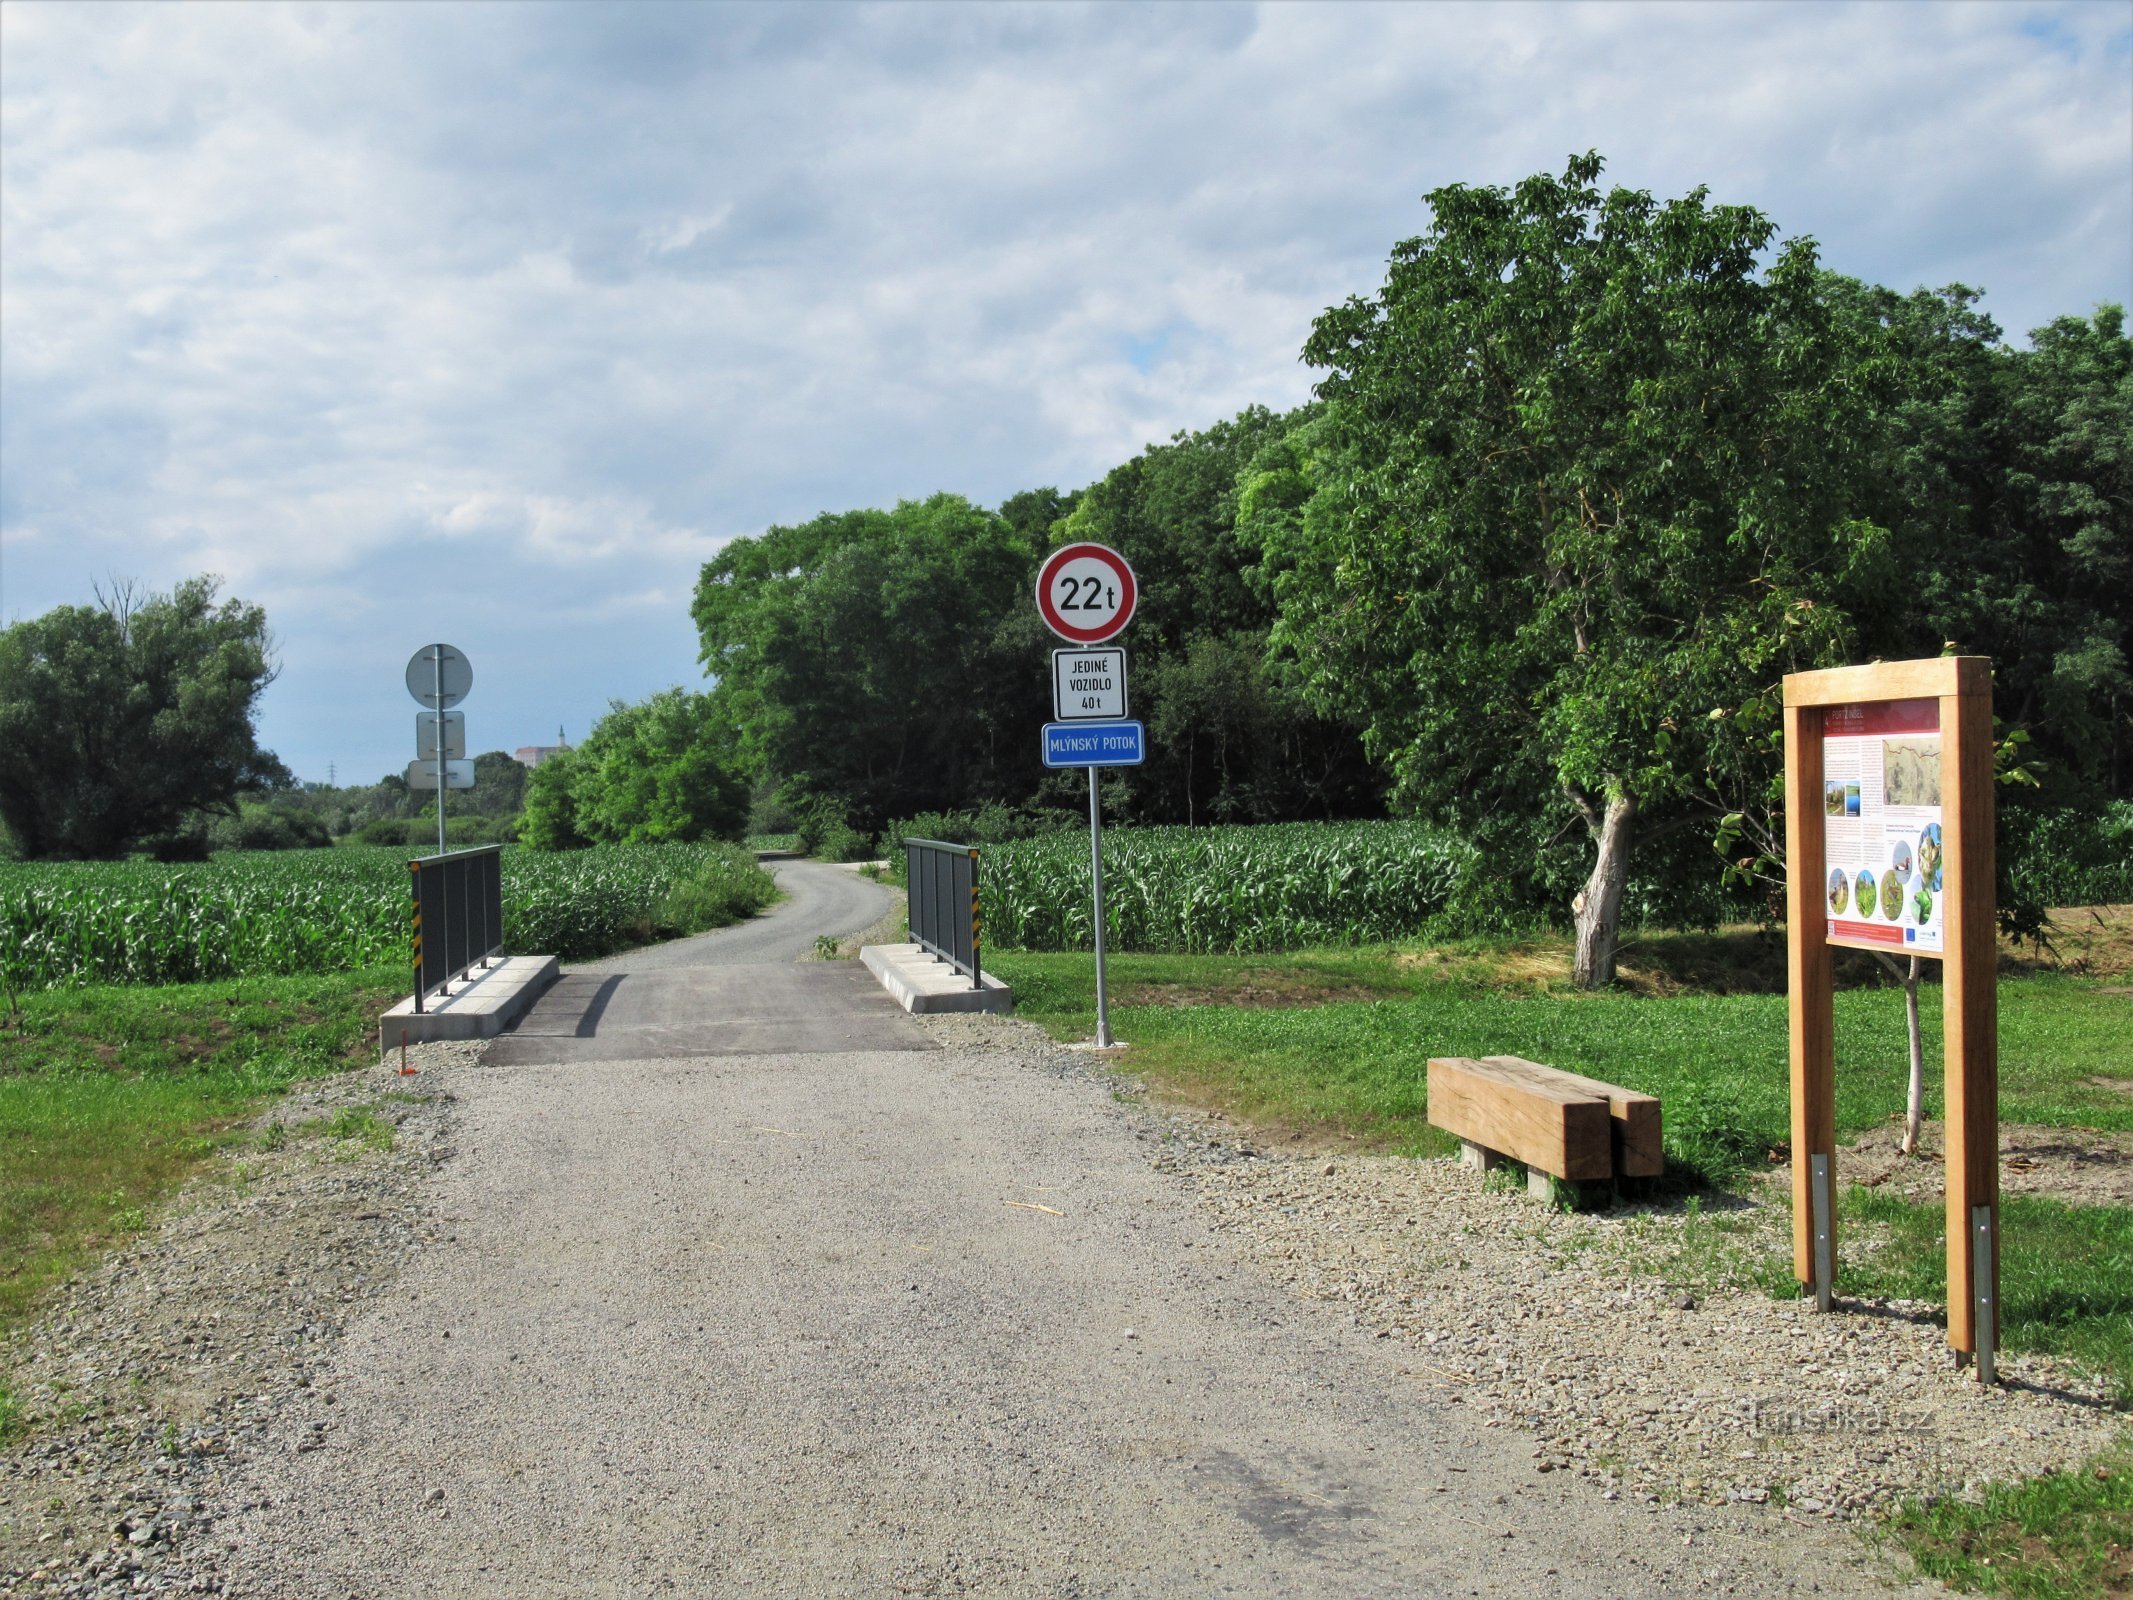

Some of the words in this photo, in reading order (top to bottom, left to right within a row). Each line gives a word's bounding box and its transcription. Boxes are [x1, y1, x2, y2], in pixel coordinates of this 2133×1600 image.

[1072, 657, 1108, 674] JEDINÉ
[1069, 678, 1112, 692] VOZIDLO
[1050, 734, 1099, 752] MLÝNSKÝ
[1103, 736, 1137, 750] POTOK
